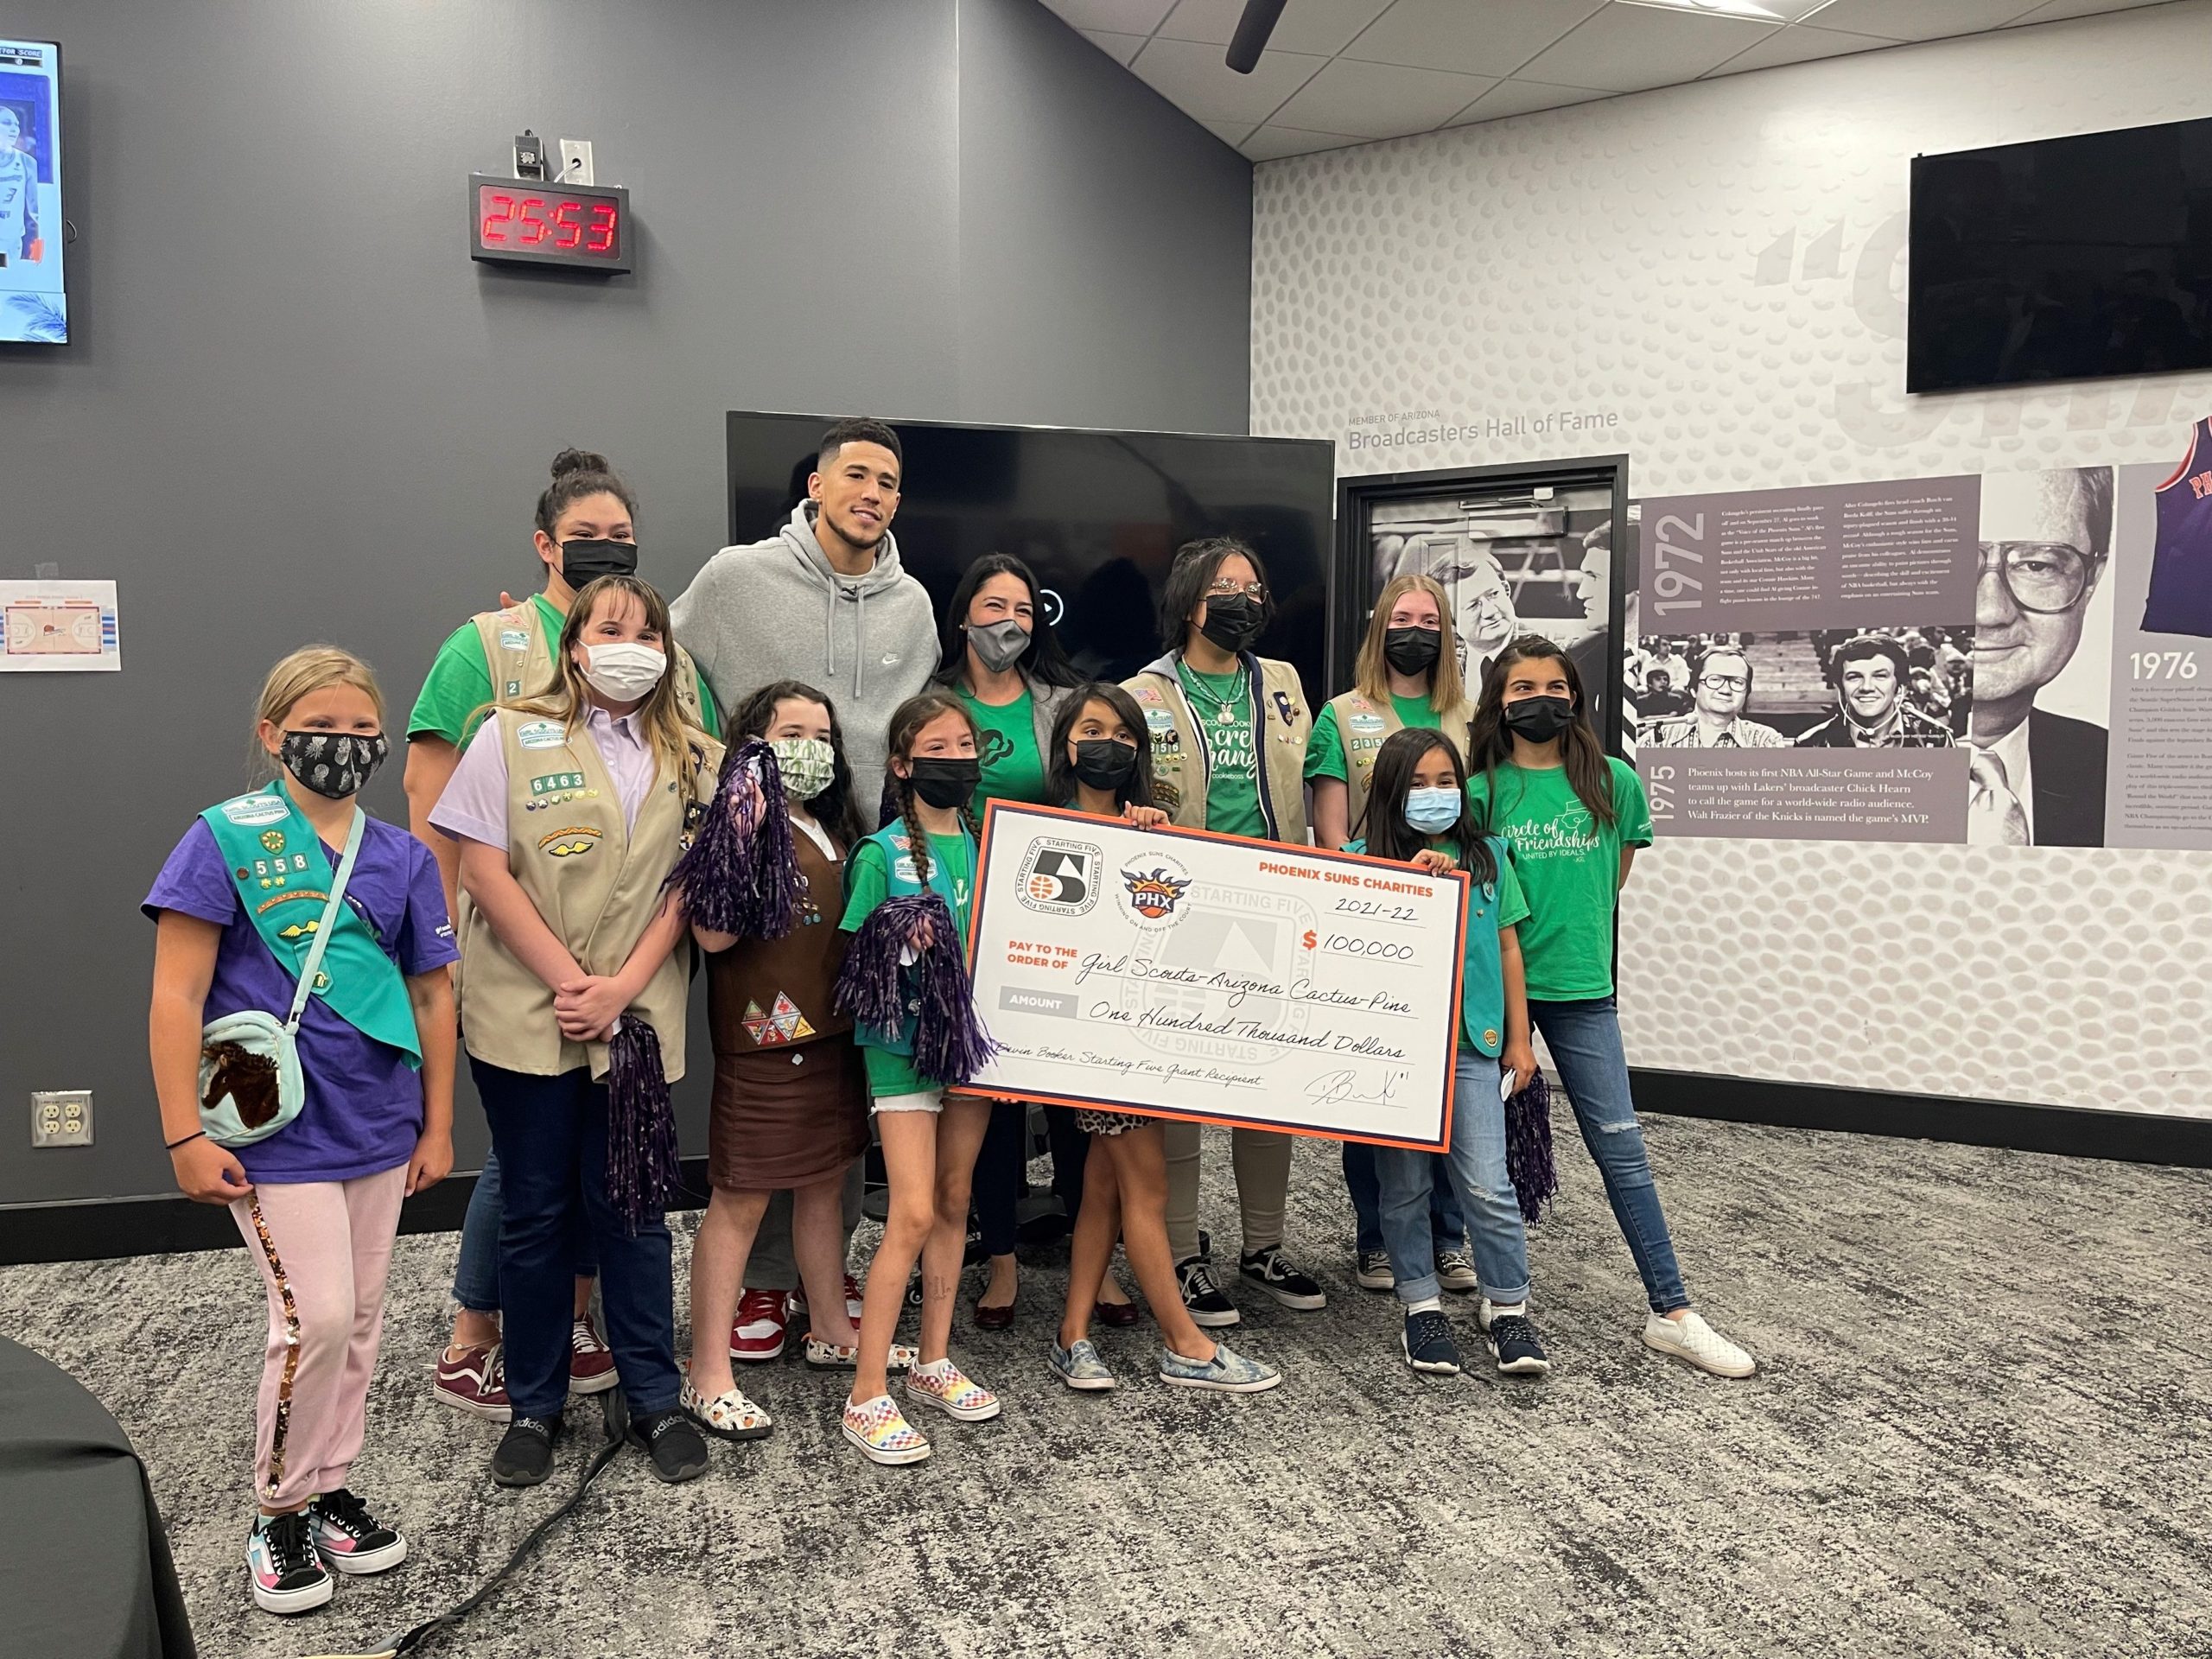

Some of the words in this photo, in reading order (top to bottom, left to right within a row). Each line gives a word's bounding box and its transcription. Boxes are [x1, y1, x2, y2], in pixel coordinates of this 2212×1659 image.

[483, 195, 616, 251] 25:53
[1349, 414, 1386, 426] MEMBER
[1387, 413, 1400, 423] OF
[1401, 410, 1440, 422] ARIZONA
[1349, 423, 1478, 450] Broadcasters
[1486, 416, 1526, 438] Hall
[1533, 415, 1554, 434] of
[1559, 411, 1618, 431] Fame
[1654, 512, 1705, 616] 1972
[2130, 652, 2197, 679] 1976
[533, 774, 583, 792] 6463
[1688, 767, 1723, 776] Phoenix
[1761, 768, 1777, 777] first
[1780, 768, 1803, 777] NBA
[1805, 768, 1841, 777] All-Star
[1843, 768, 1873, 778] Game
[1875, 769, 1894, 778] and
[1897, 768, 1933, 780] McCoy
[1649, 766, 1675, 823] 1975
[1716, 785, 1728, 793] up
[1731, 782, 1751, 791] with
[1789, 783, 1844, 791] broadcaster
[1847, 783, 1875, 792] Chick
[1878, 784, 1910, 793] Hearn
[1699, 796, 1714, 804] call
[1761, 797, 1774, 805] for
[1784, 797, 1837, 806] world-wide
[1840, 798, 1866, 807] radio
[1867, 798, 1914, 808] audience.
[1688, 810, 1707, 818] Walt
[1710, 810, 1740, 819] Frazier
[1755, 811, 1769, 820] the
[1772, 811, 1802, 821] Knicks
[1805, 812, 1812, 821] is
[1814, 812, 1846, 822] named
[1848, 813, 1863, 822] the
[1866, 813, 1898, 824] game's
[1901, 814, 1929, 823] MVP.
[1501, 819, 1541, 837] Circle
[1543, 818, 1559, 838] of
[1046, 839, 1083, 850] STARTING
[1084, 845, 1100, 856] FIVE
[1515, 830, 1600, 852] Friendships
[1018, 856, 1033, 893] STARTING
[1028, 838, 1041, 855] FIVE
[1124, 851, 1147, 868] PHOENIX
[1165, 853, 1189, 877] CHARITIES
[1090, 861, 1100, 899] STARTING
[1259, 861, 1321, 880] PHOENIX
[1324, 872, 1360, 887] SUNS
[1363, 878, 1433, 898] CHARITIES
[1021, 895, 1038, 909] FIVE
[1039, 903, 1076, 914] STARTING
[1079, 899, 1095, 913] FIVE
[1135, 893, 1174, 912] PHX
[1191, 886, 1272, 909] STARTING
[1276, 898, 1313, 925] FIVE
[1335, 898, 1419, 921] 2021-22
[1115, 893, 1129, 920] WINNING
[1129, 918, 1139, 927] ON
[1139, 924, 1153, 933] AND
[1167, 921, 1179, 930] THE
[1179, 902, 1192, 922] COURT
[1009, 940, 1033, 951] PAY
[1036, 944, 1052, 954] TO
[1055, 946, 1078, 957] THE
[1302, 930, 1318, 950] $
[1324, 934, 1414, 959] 100,000
[1007, 954, 1048, 968] ORDER
[1052, 959, 1069, 969] OF
[1075, 953, 1128, 985] Girl
[1290, 978, 1411, 1013] Cactus-Pine
[1008, 995, 1063, 1009] AMOUNT
[1090, 1001, 1132, 1021] One
[1138, 1006, 1235, 1035] Hundred
[1237, 1021, 1332, 1048] Thousand
[1334, 1035, 1406, 1058] Dollars
[1037, 1046, 1075, 1061] Booker
[1079, 1052, 1134, 1076] Starting
[1136, 1059, 1164, 1072] Five
[1164, 1064, 1203, 1084] Grant
[1205, 1068, 1264, 1088] Recipient
[513, 1417, 549, 1437] adidas
